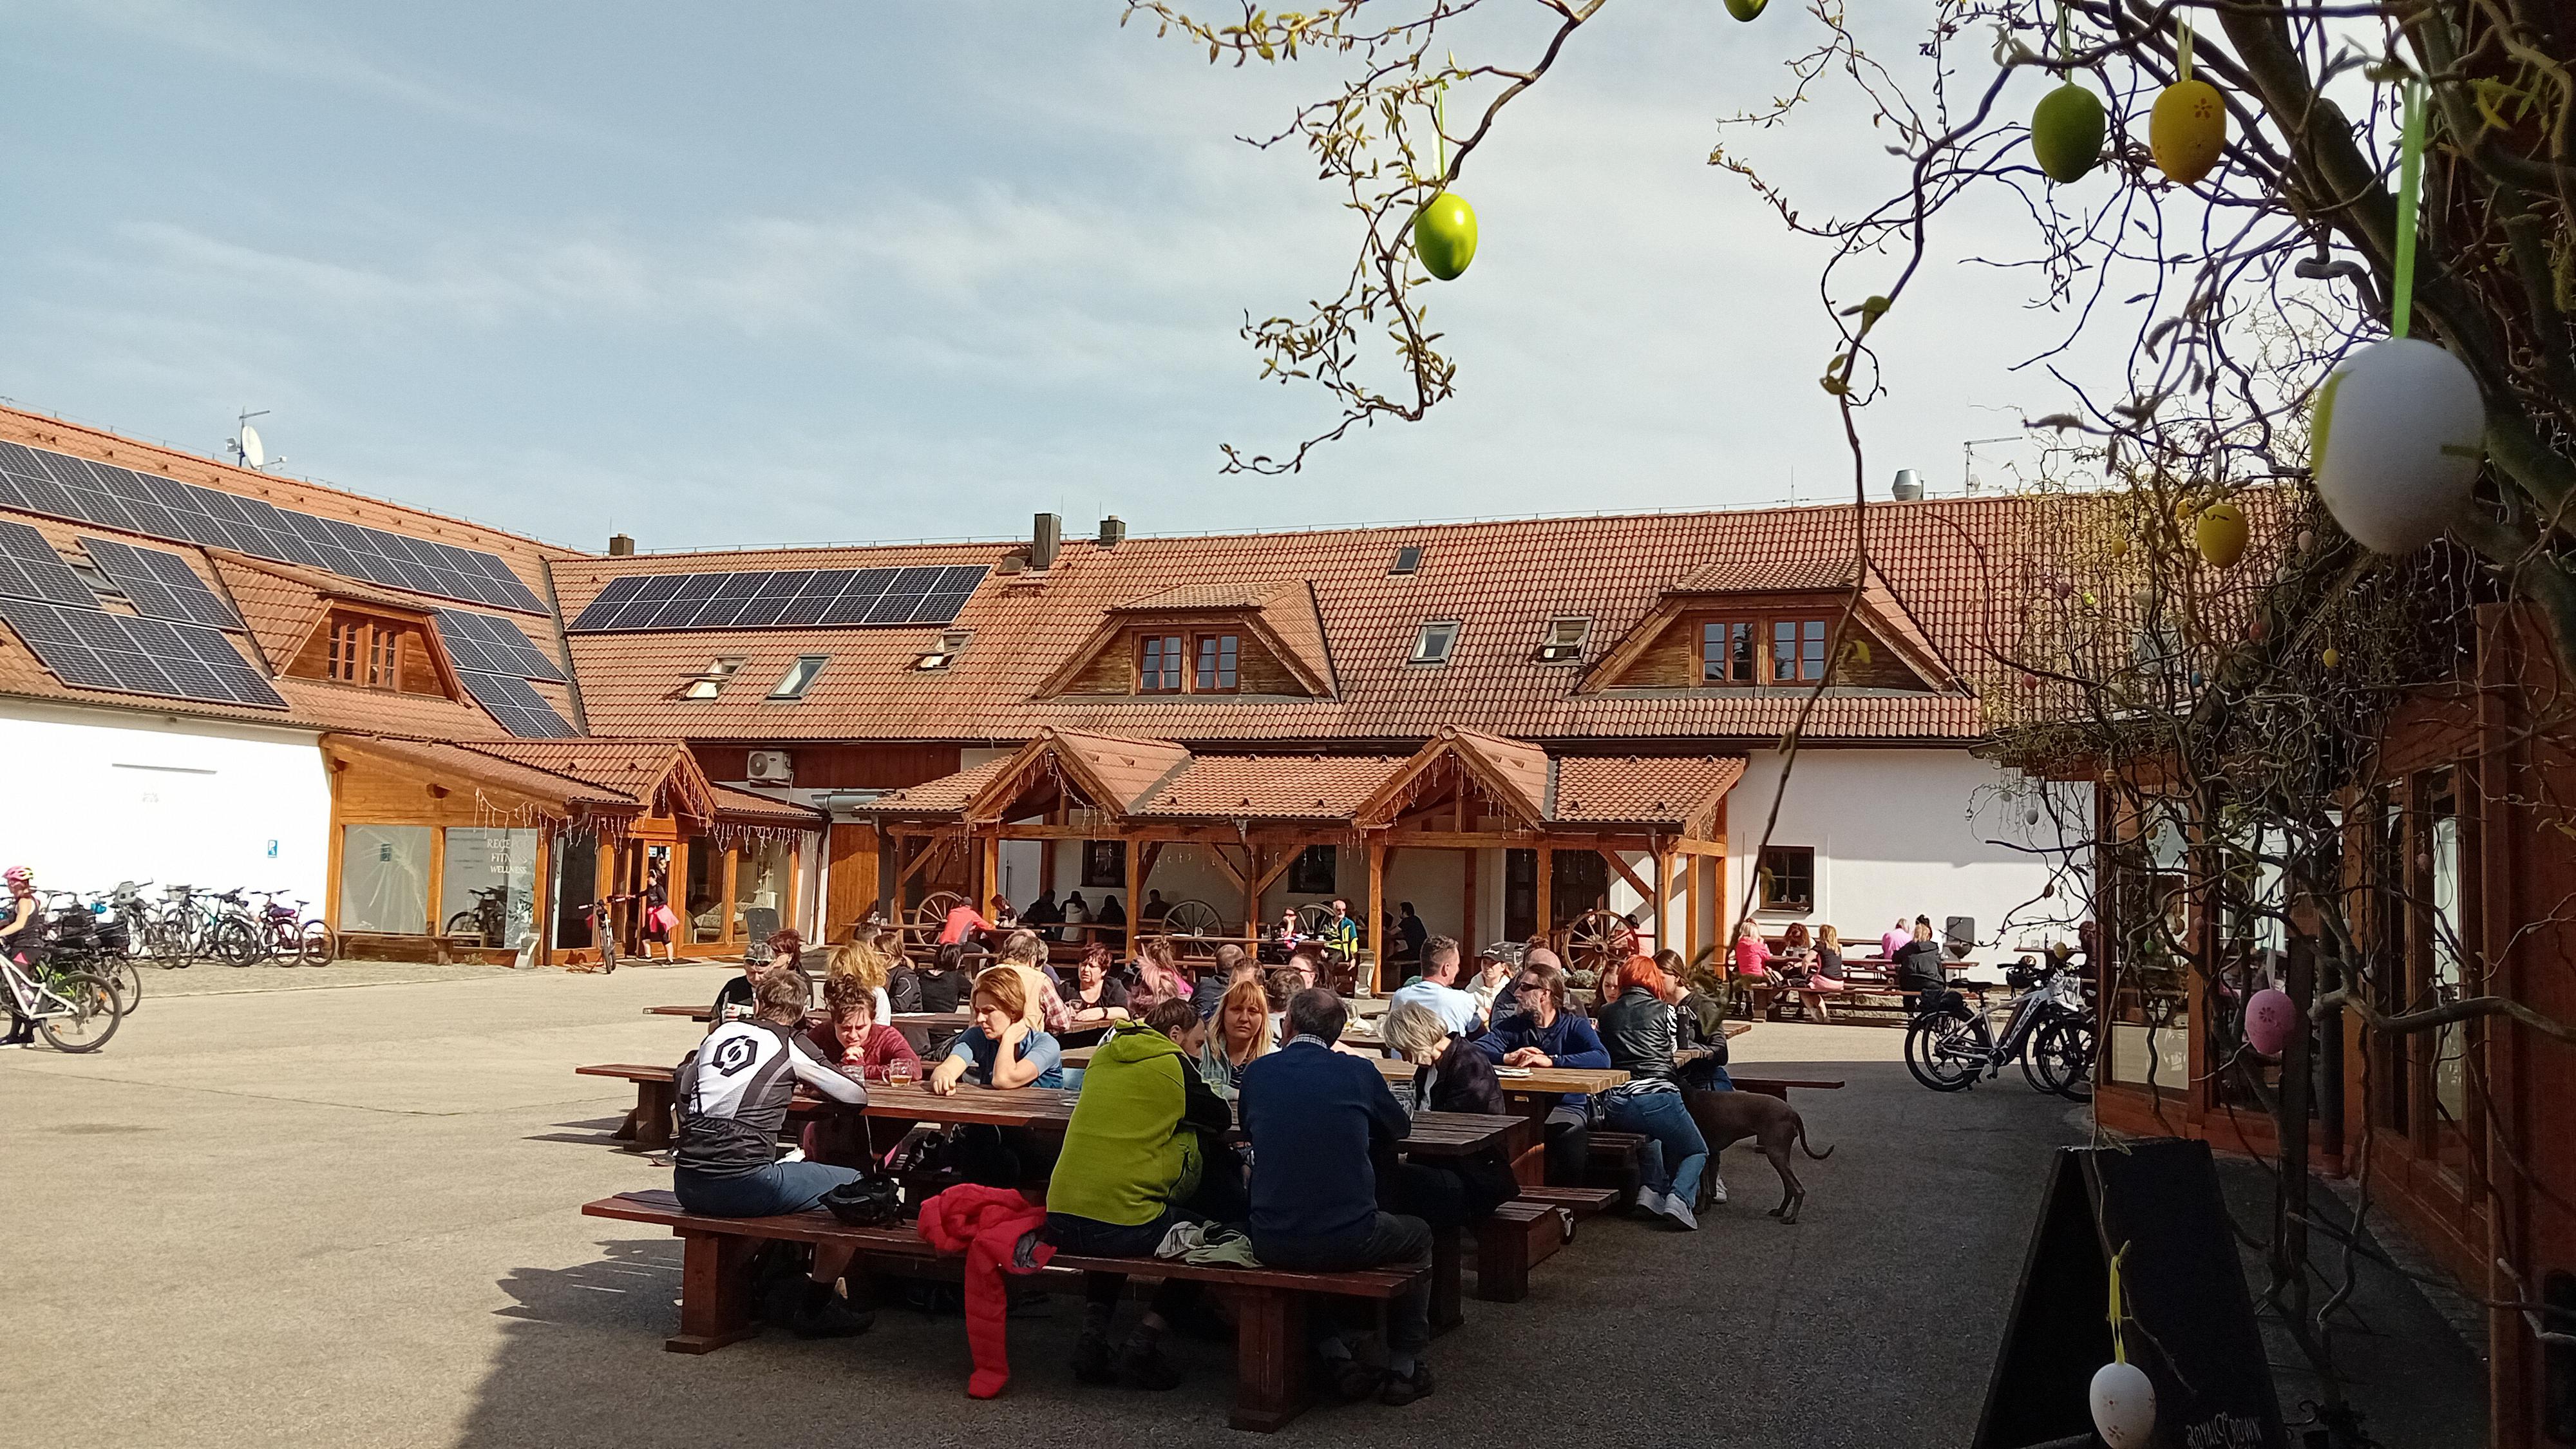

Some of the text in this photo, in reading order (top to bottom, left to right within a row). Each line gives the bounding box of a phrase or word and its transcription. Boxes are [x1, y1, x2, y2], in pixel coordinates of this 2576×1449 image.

[487, 838, 530, 849] RECECE
[490, 866, 527, 874] WELLNESS
[2185, 1411, 2262, 1449] ROYAL CROWN
